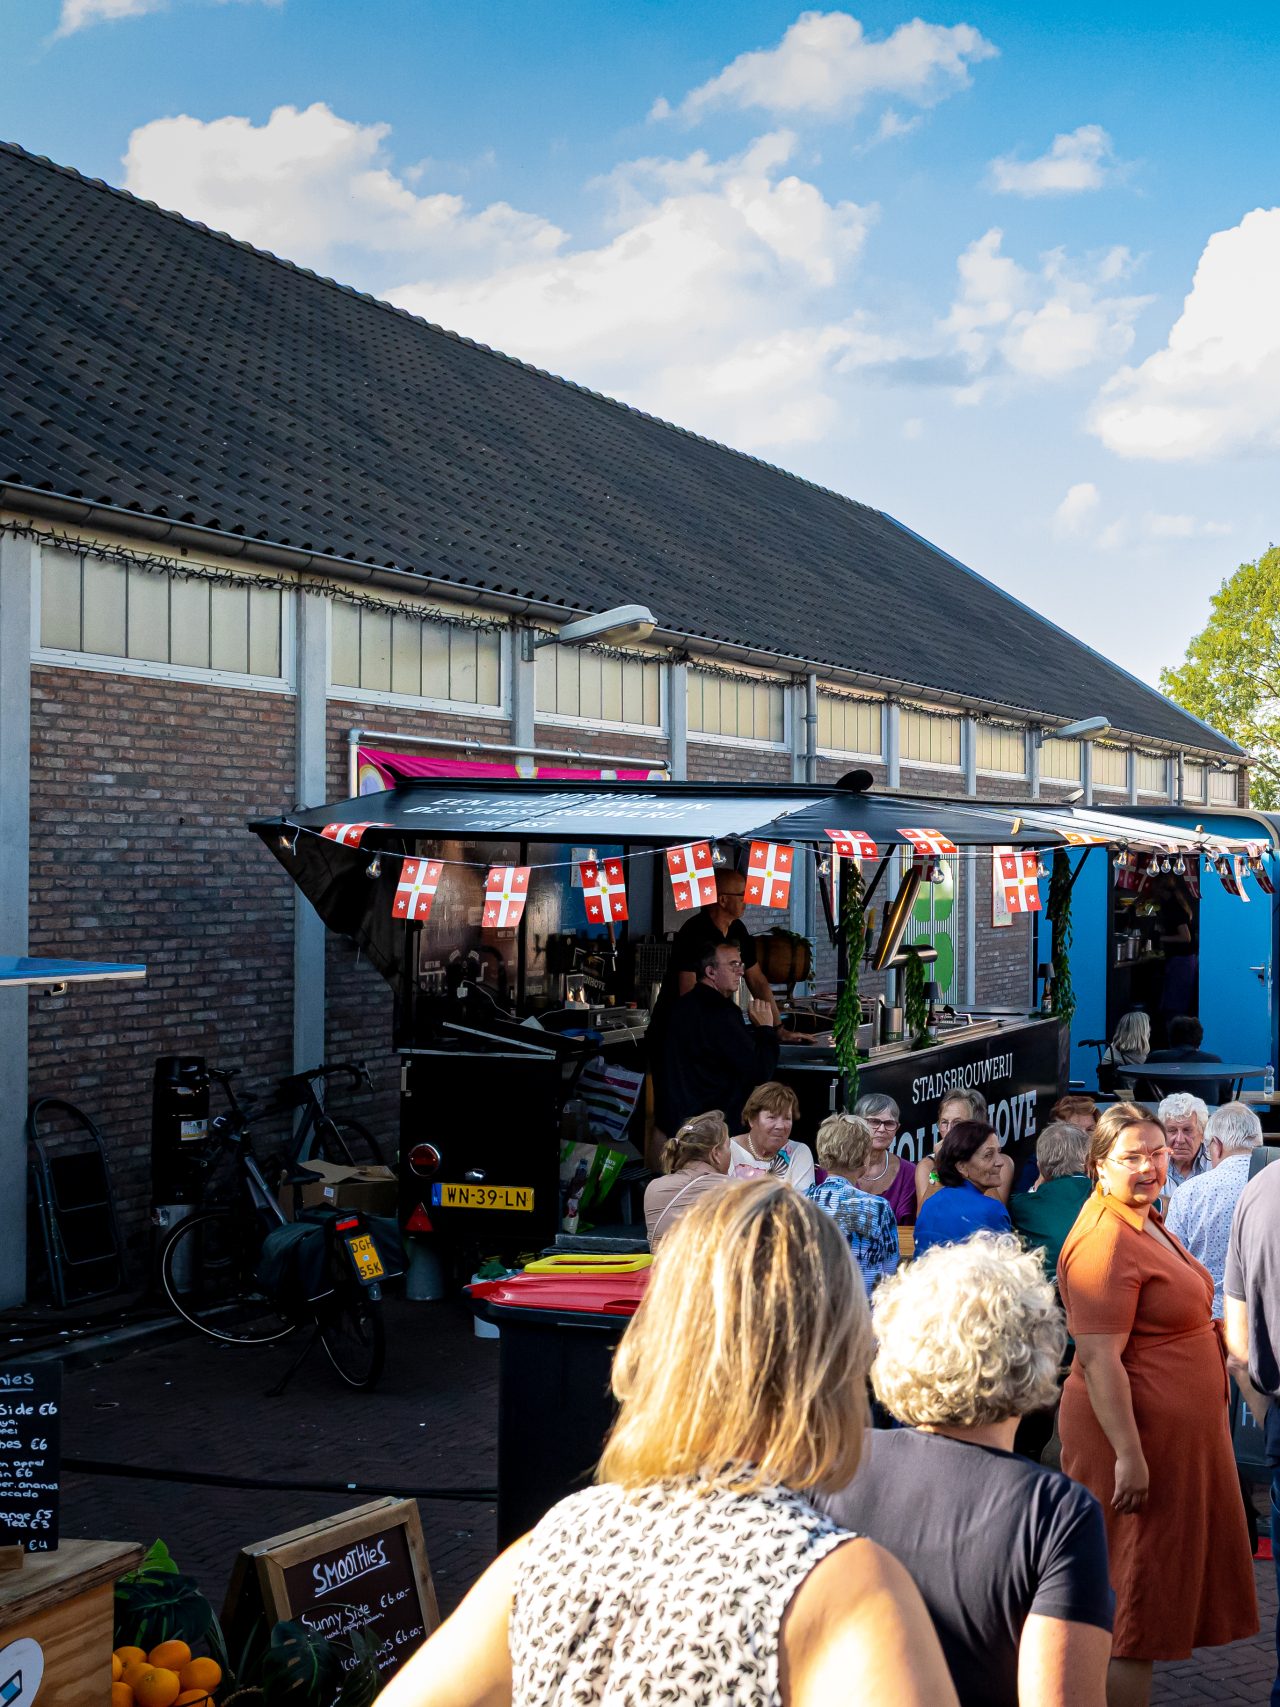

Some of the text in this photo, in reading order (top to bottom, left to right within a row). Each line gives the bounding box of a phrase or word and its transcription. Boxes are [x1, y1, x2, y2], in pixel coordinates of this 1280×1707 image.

[912, 1053, 1013, 1104] STADSBROUWERIJ
[447, 1187, 527, 1207] WN-39-LN
[351, 1239, 374, 1254] DGH
[360, 1261, 382, 1278] 55K
